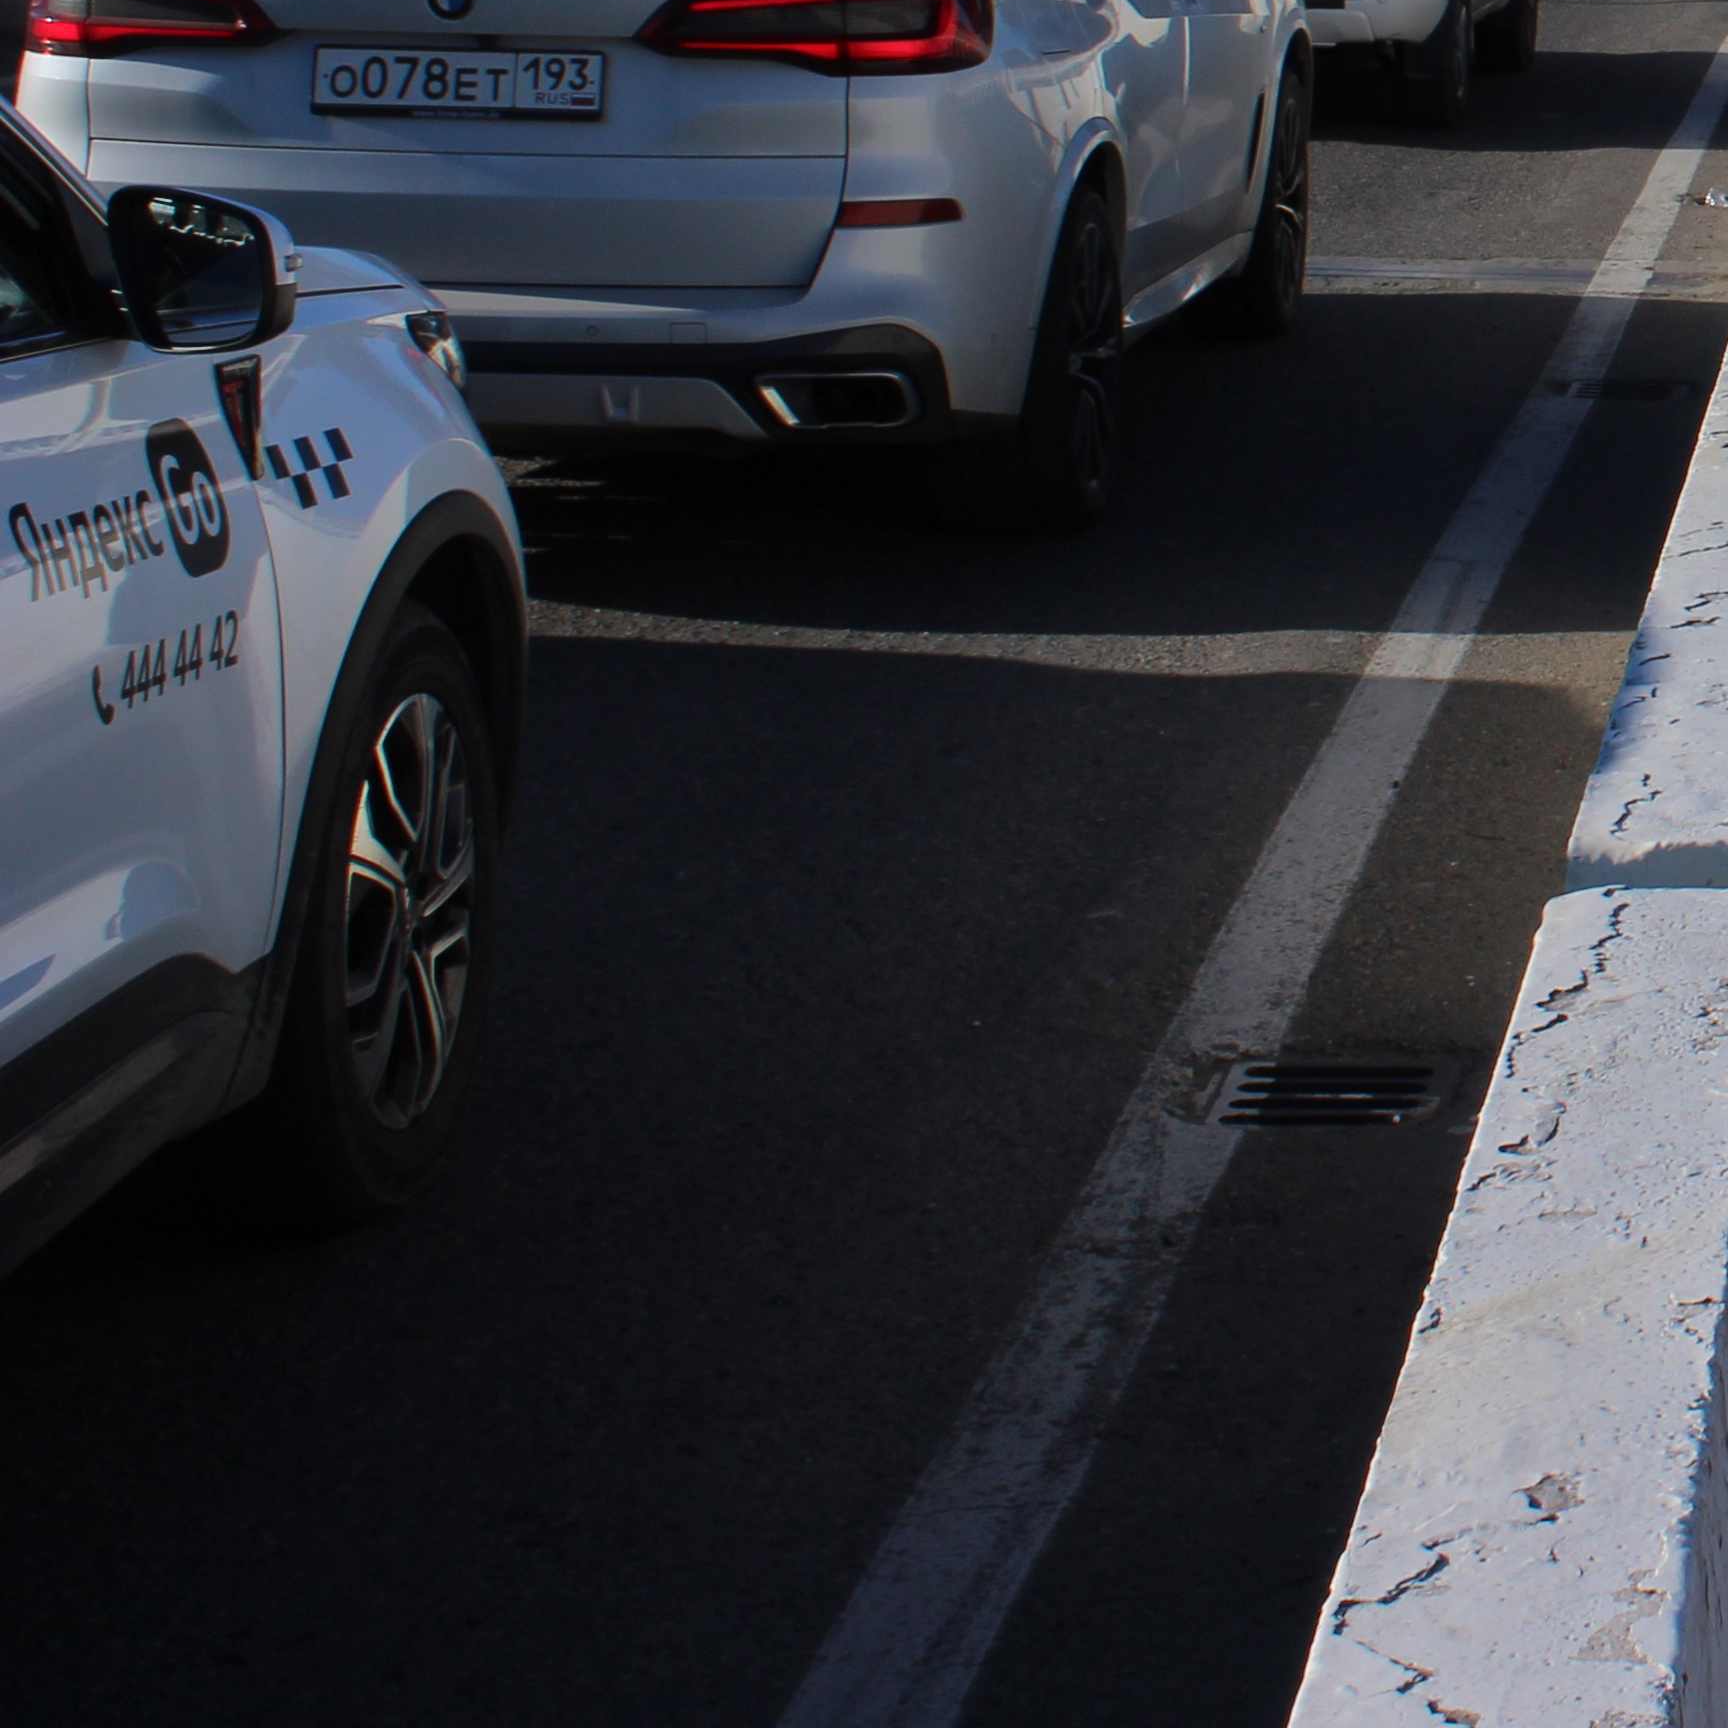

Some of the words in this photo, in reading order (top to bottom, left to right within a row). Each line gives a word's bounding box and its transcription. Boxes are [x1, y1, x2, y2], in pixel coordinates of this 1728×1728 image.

[522, 57, 591, 91] 193
[536, 91, 570, 106] RUS
[9, 489, 165, 602] Яндекс
[160, 454, 222, 545] Go
[120, 638, 167, 709] 444
[173, 622, 204, 687] 44
[210, 609, 239, 671] 42
